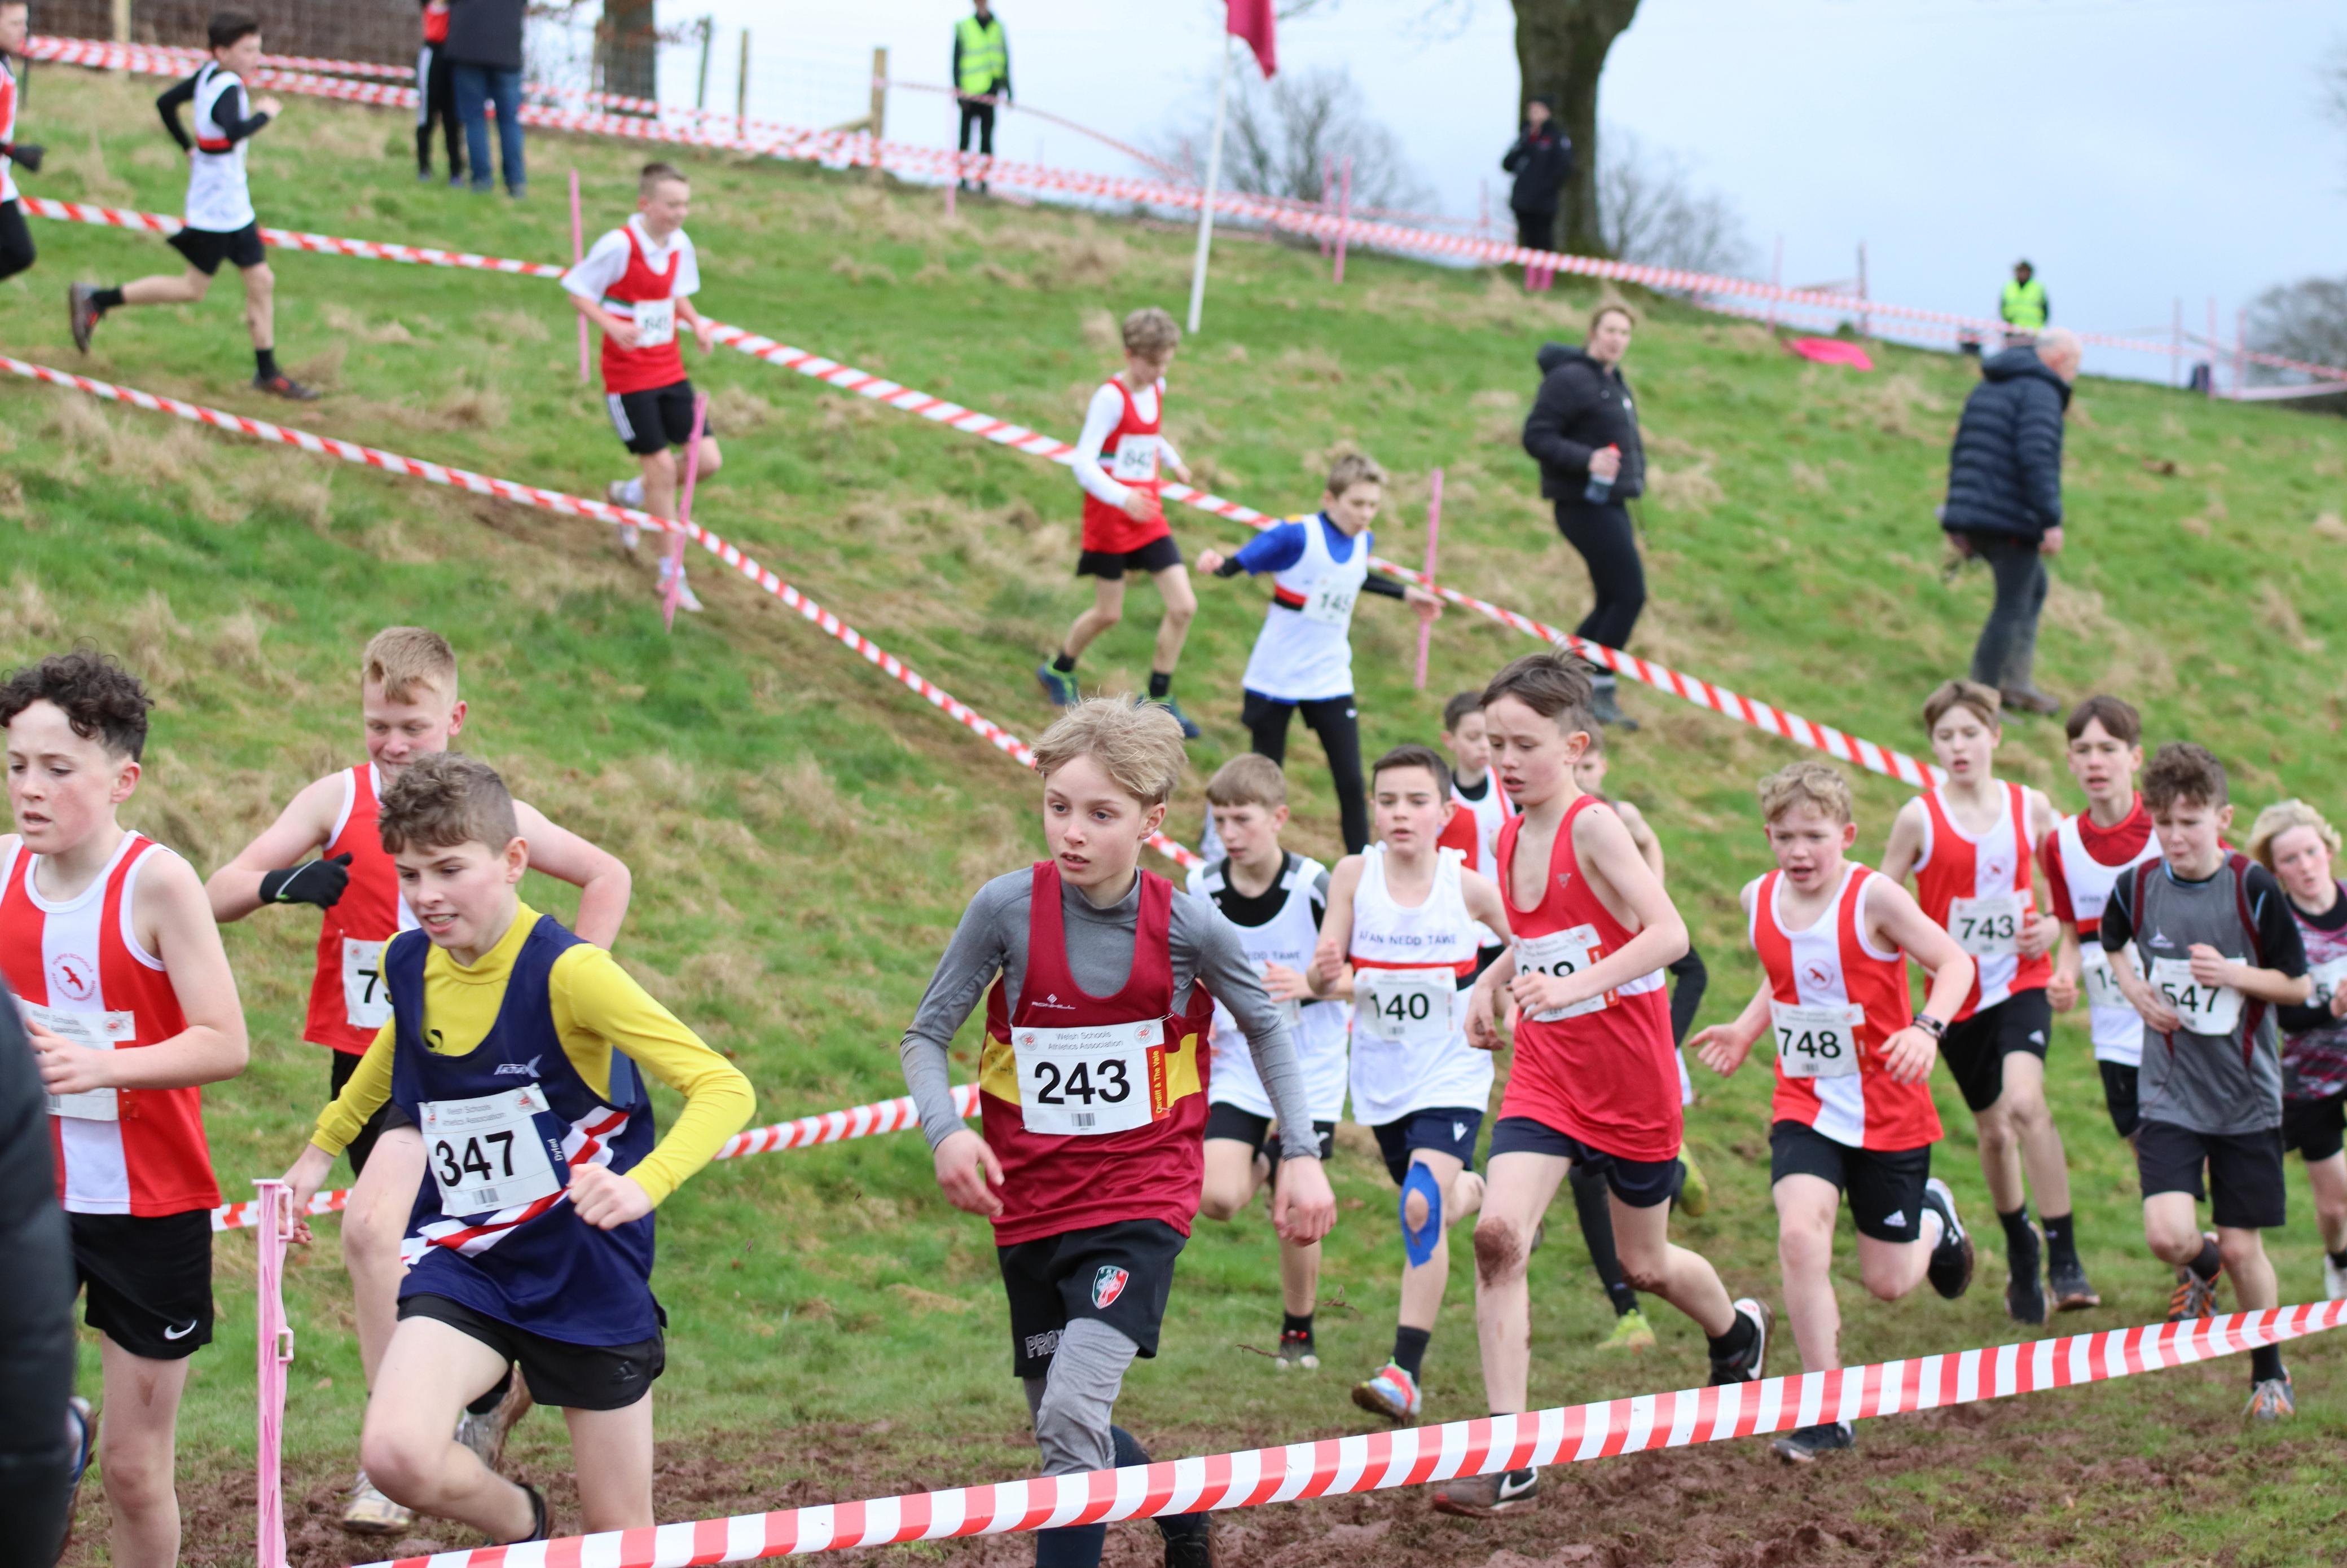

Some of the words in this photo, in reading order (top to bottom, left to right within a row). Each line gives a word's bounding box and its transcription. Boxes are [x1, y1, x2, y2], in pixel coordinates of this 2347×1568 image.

[1959, 914, 2015, 940] 743
[1370, 993, 1430, 1021] 140
[2161, 983, 2221, 1013] 547
[1080, 1040, 1123, 1049] Association
[1779, 1027, 1841, 1059] 748
[1034, 1059, 1131, 1104] 243
[436, 1130, 513, 1187] 347
